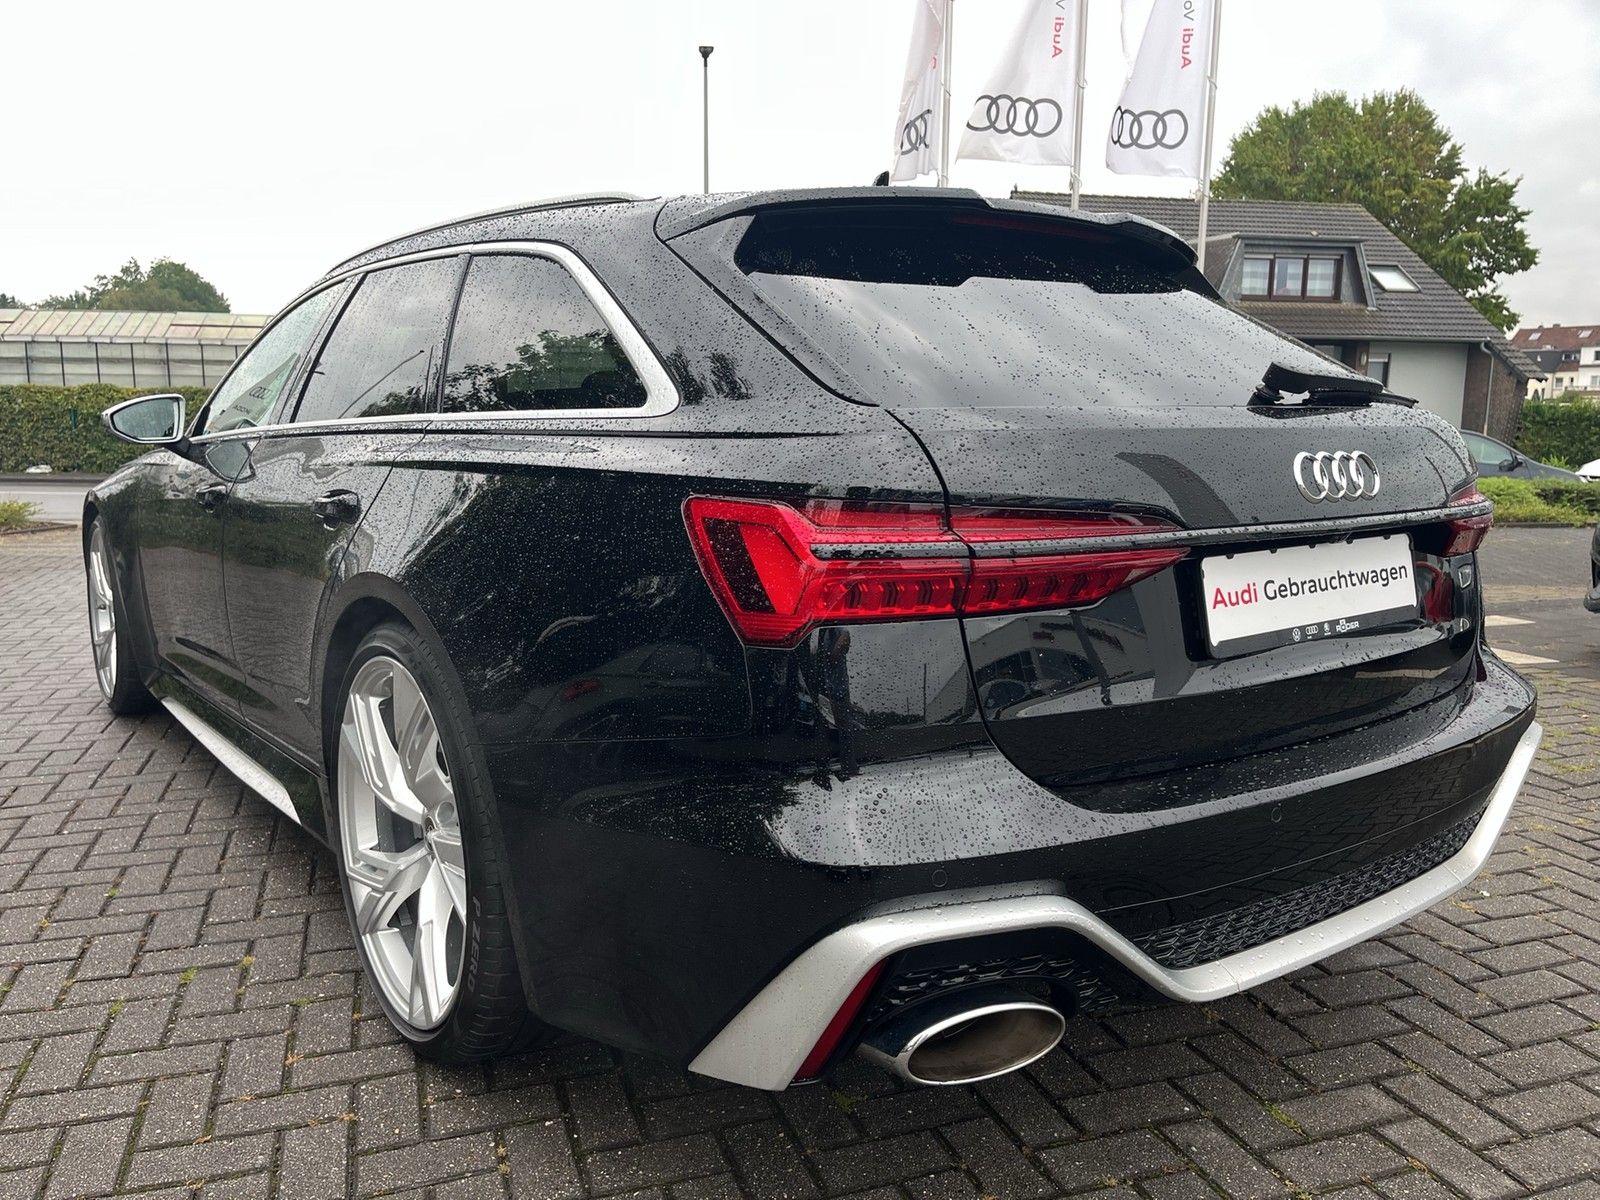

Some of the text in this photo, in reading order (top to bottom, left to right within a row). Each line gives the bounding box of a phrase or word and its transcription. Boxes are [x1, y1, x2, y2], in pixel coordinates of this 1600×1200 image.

[1212, 564, 1408, 610] Audi Gebrauchtwagen
[467, 920, 481, 993] ZERO
